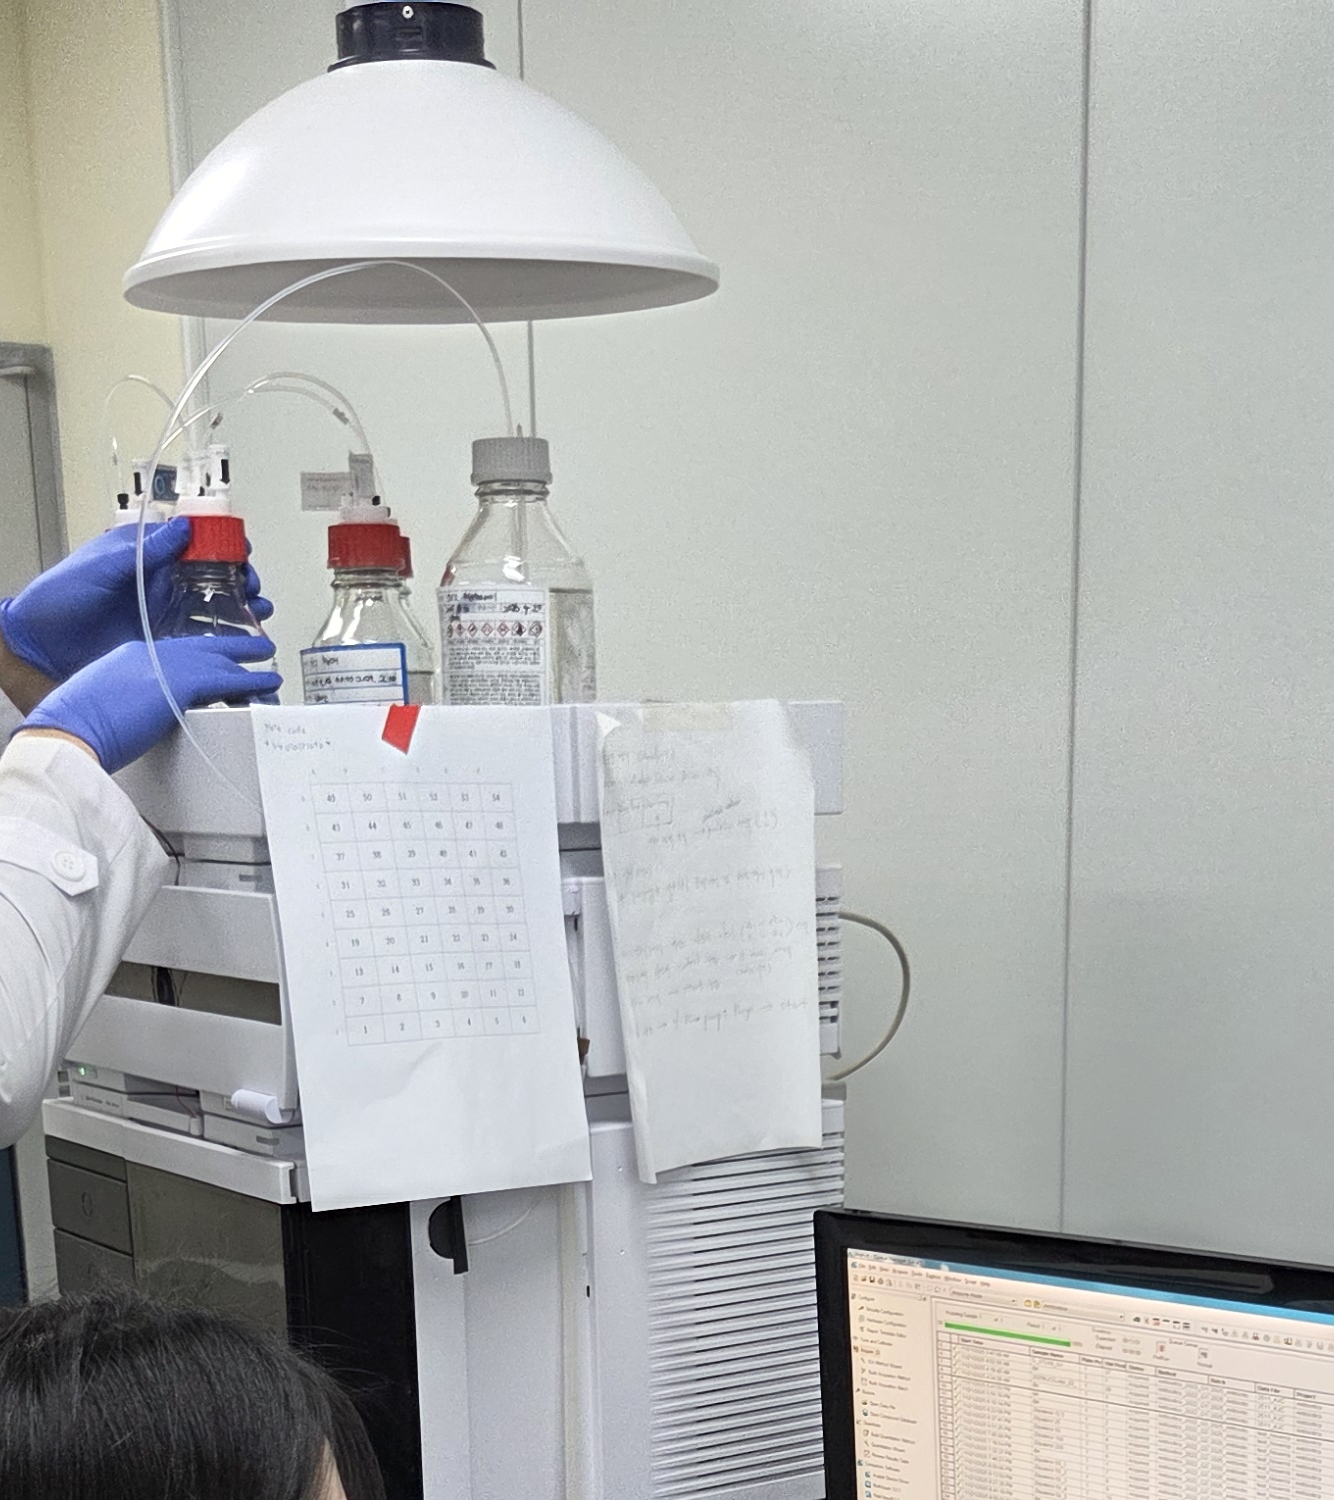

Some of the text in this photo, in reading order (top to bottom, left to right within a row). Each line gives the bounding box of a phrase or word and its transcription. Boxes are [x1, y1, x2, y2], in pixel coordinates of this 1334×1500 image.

[327, 794, 335, 802] 49
[363, 793, 372, 801] 50
[398, 792, 406, 800] 51
[429, 792, 438, 801] 52
[492, 793, 500, 801] 54
[369, 822, 376, 830] 44
[464, 821, 474, 830] 47
[336, 853, 345, 861] 37
[342, 881, 349, 889] 31
[346, 910, 355, 918] 25
[382, 908, 391, 916] 26
[416, 907, 423, 915] 27
[448, 906, 456, 914] 28
[386, 937, 395, 945] 20
[420, 935, 428, 943] 21
[452, 934, 460, 942] 22
[510, 933, 517, 941] 24
[356, 967, 363, 976] 13
[426, 963, 433, 971] 15
[484, 962, 494, 970] 17
[489, 990, 498, 998] 11
